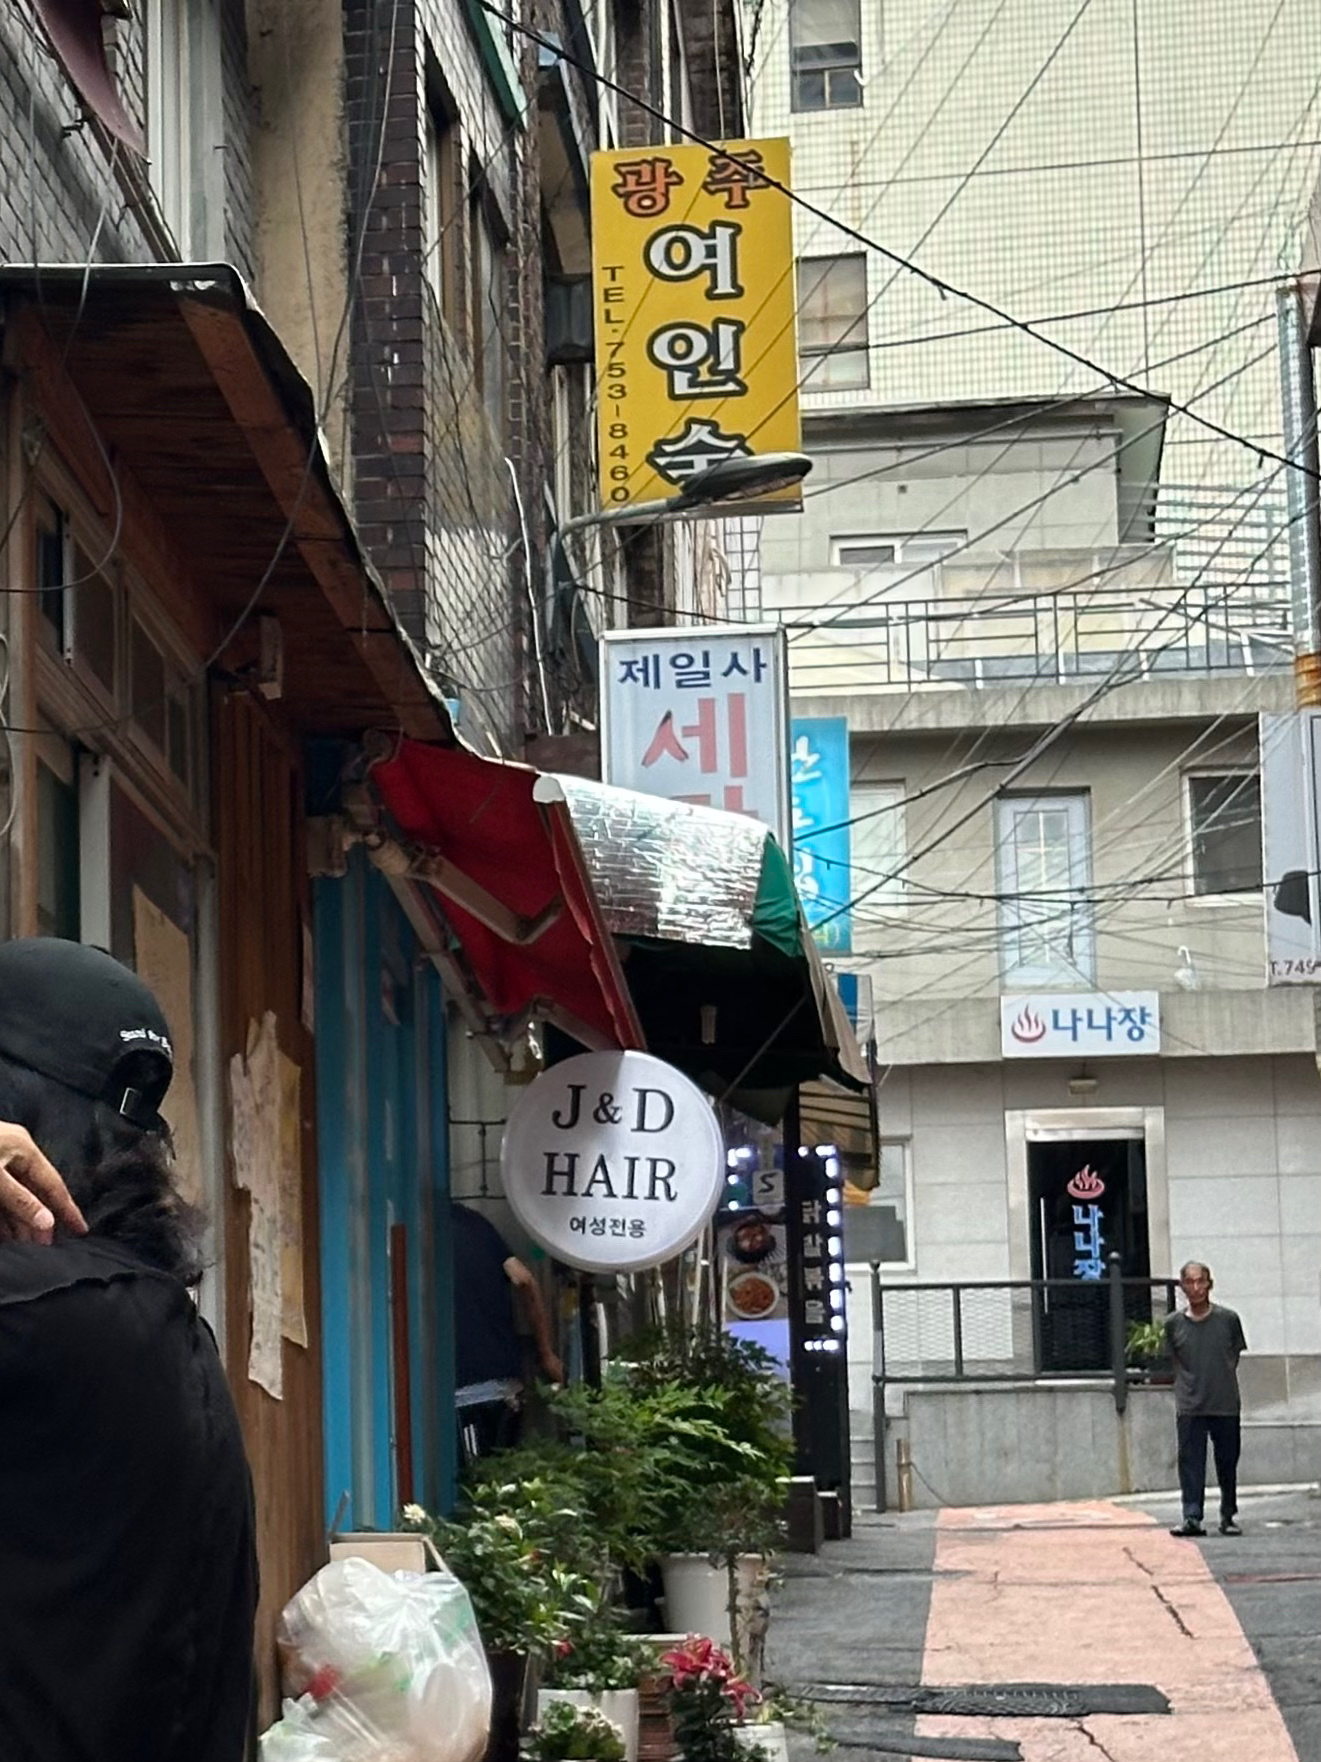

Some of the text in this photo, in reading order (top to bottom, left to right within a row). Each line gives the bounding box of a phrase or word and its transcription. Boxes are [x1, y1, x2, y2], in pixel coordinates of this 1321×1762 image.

[611, 150, 771, 217] 광주
[617, 648, 767, 690] 제일사
[1051, 1004, 1154, 1042] 나나장
[541, 1152, 678, 1202] HAIR
[569, 1216, 647, 1238] 여성전용
